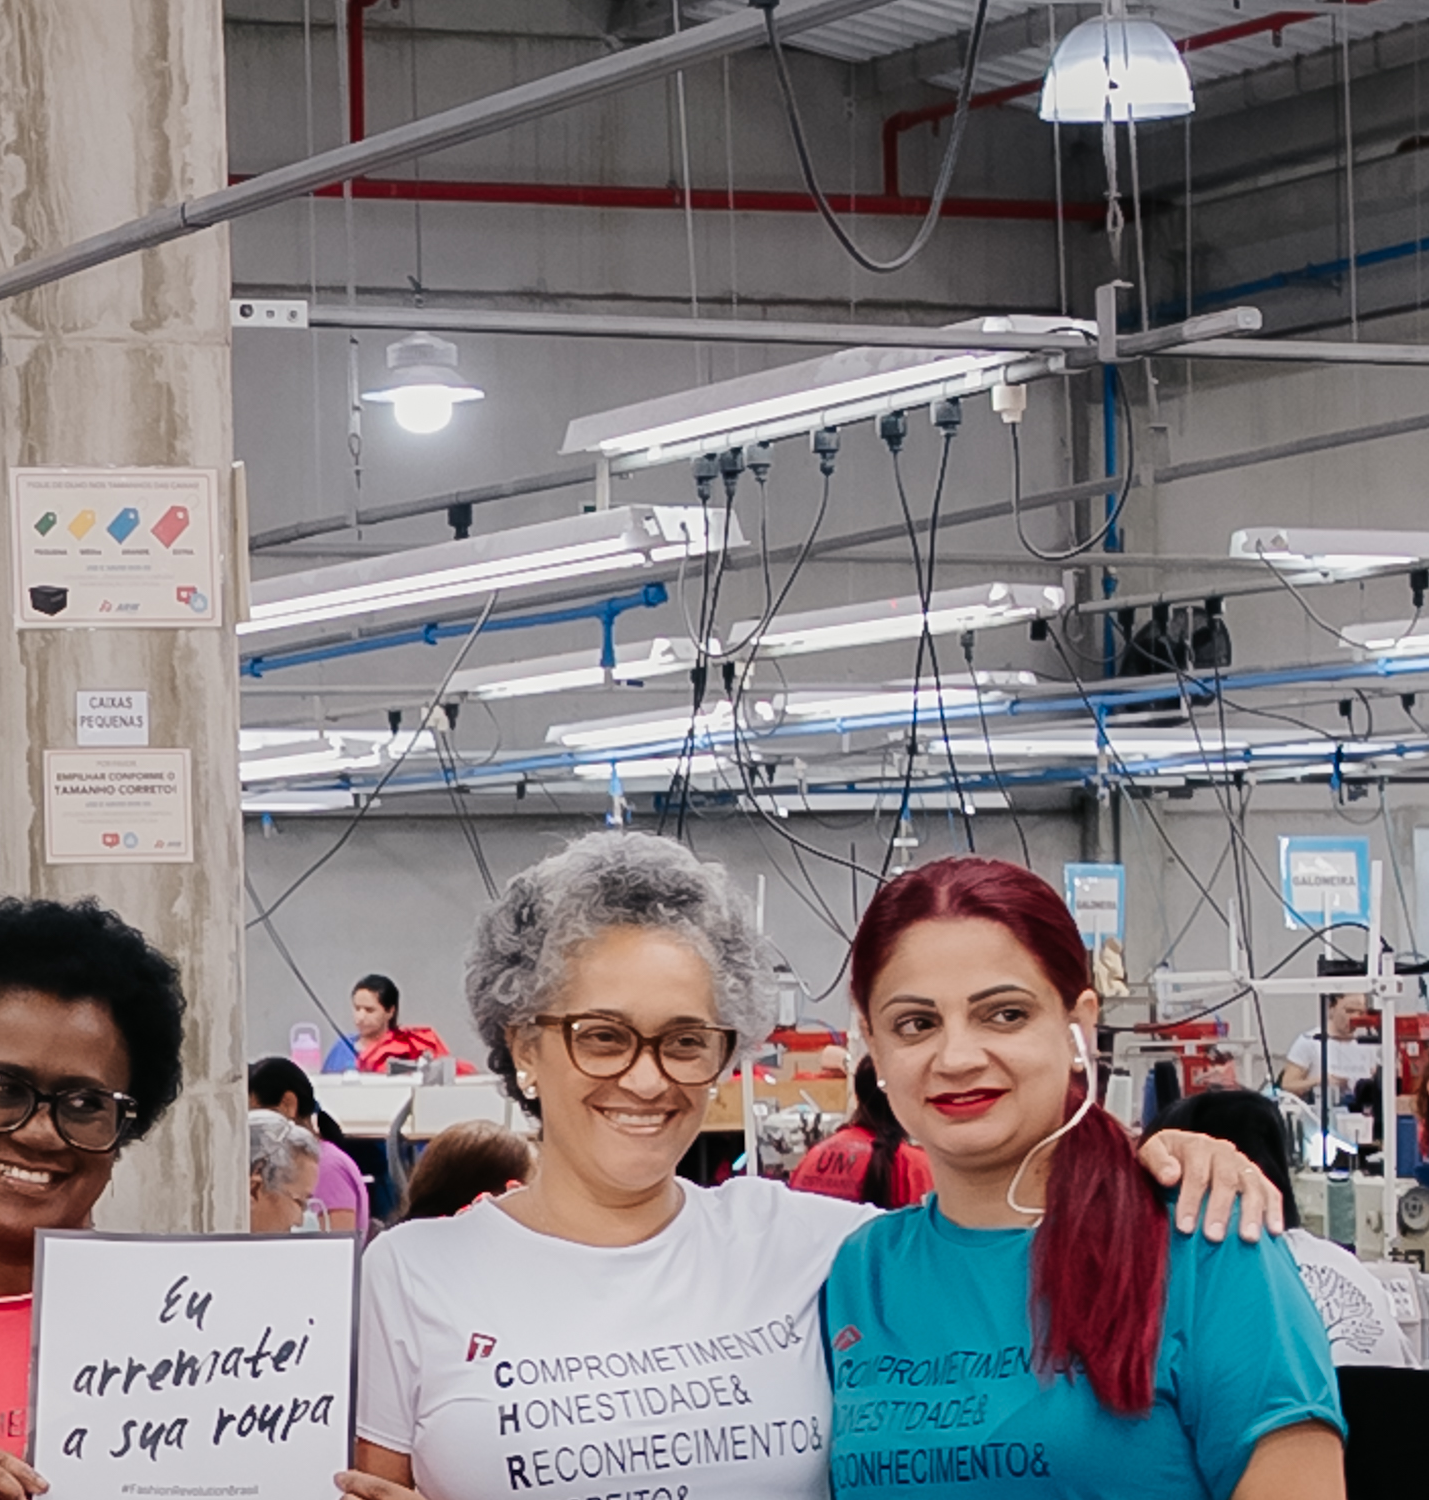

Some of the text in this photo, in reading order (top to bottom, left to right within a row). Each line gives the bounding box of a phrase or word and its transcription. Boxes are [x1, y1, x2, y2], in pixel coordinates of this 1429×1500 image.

[80, 715, 144, 728] PEQUENAS
[88, 696, 132, 709] CAIXAS
[54, 785, 116, 796] TAMANHO
[56, 772, 106, 781] EMPILHAR
[159, 1275, 213, 1331] Eu
[73, 1317, 315, 1397] arrematei
[494, 1314, 803, 1389] COMPROMETIMENTO&
[62, 1394, 334, 1462] a sua roupa
[498, 1374, 753, 1436] HONESTIDADE&
[505, 1416, 824, 1491] RECONHECIMENTO&
